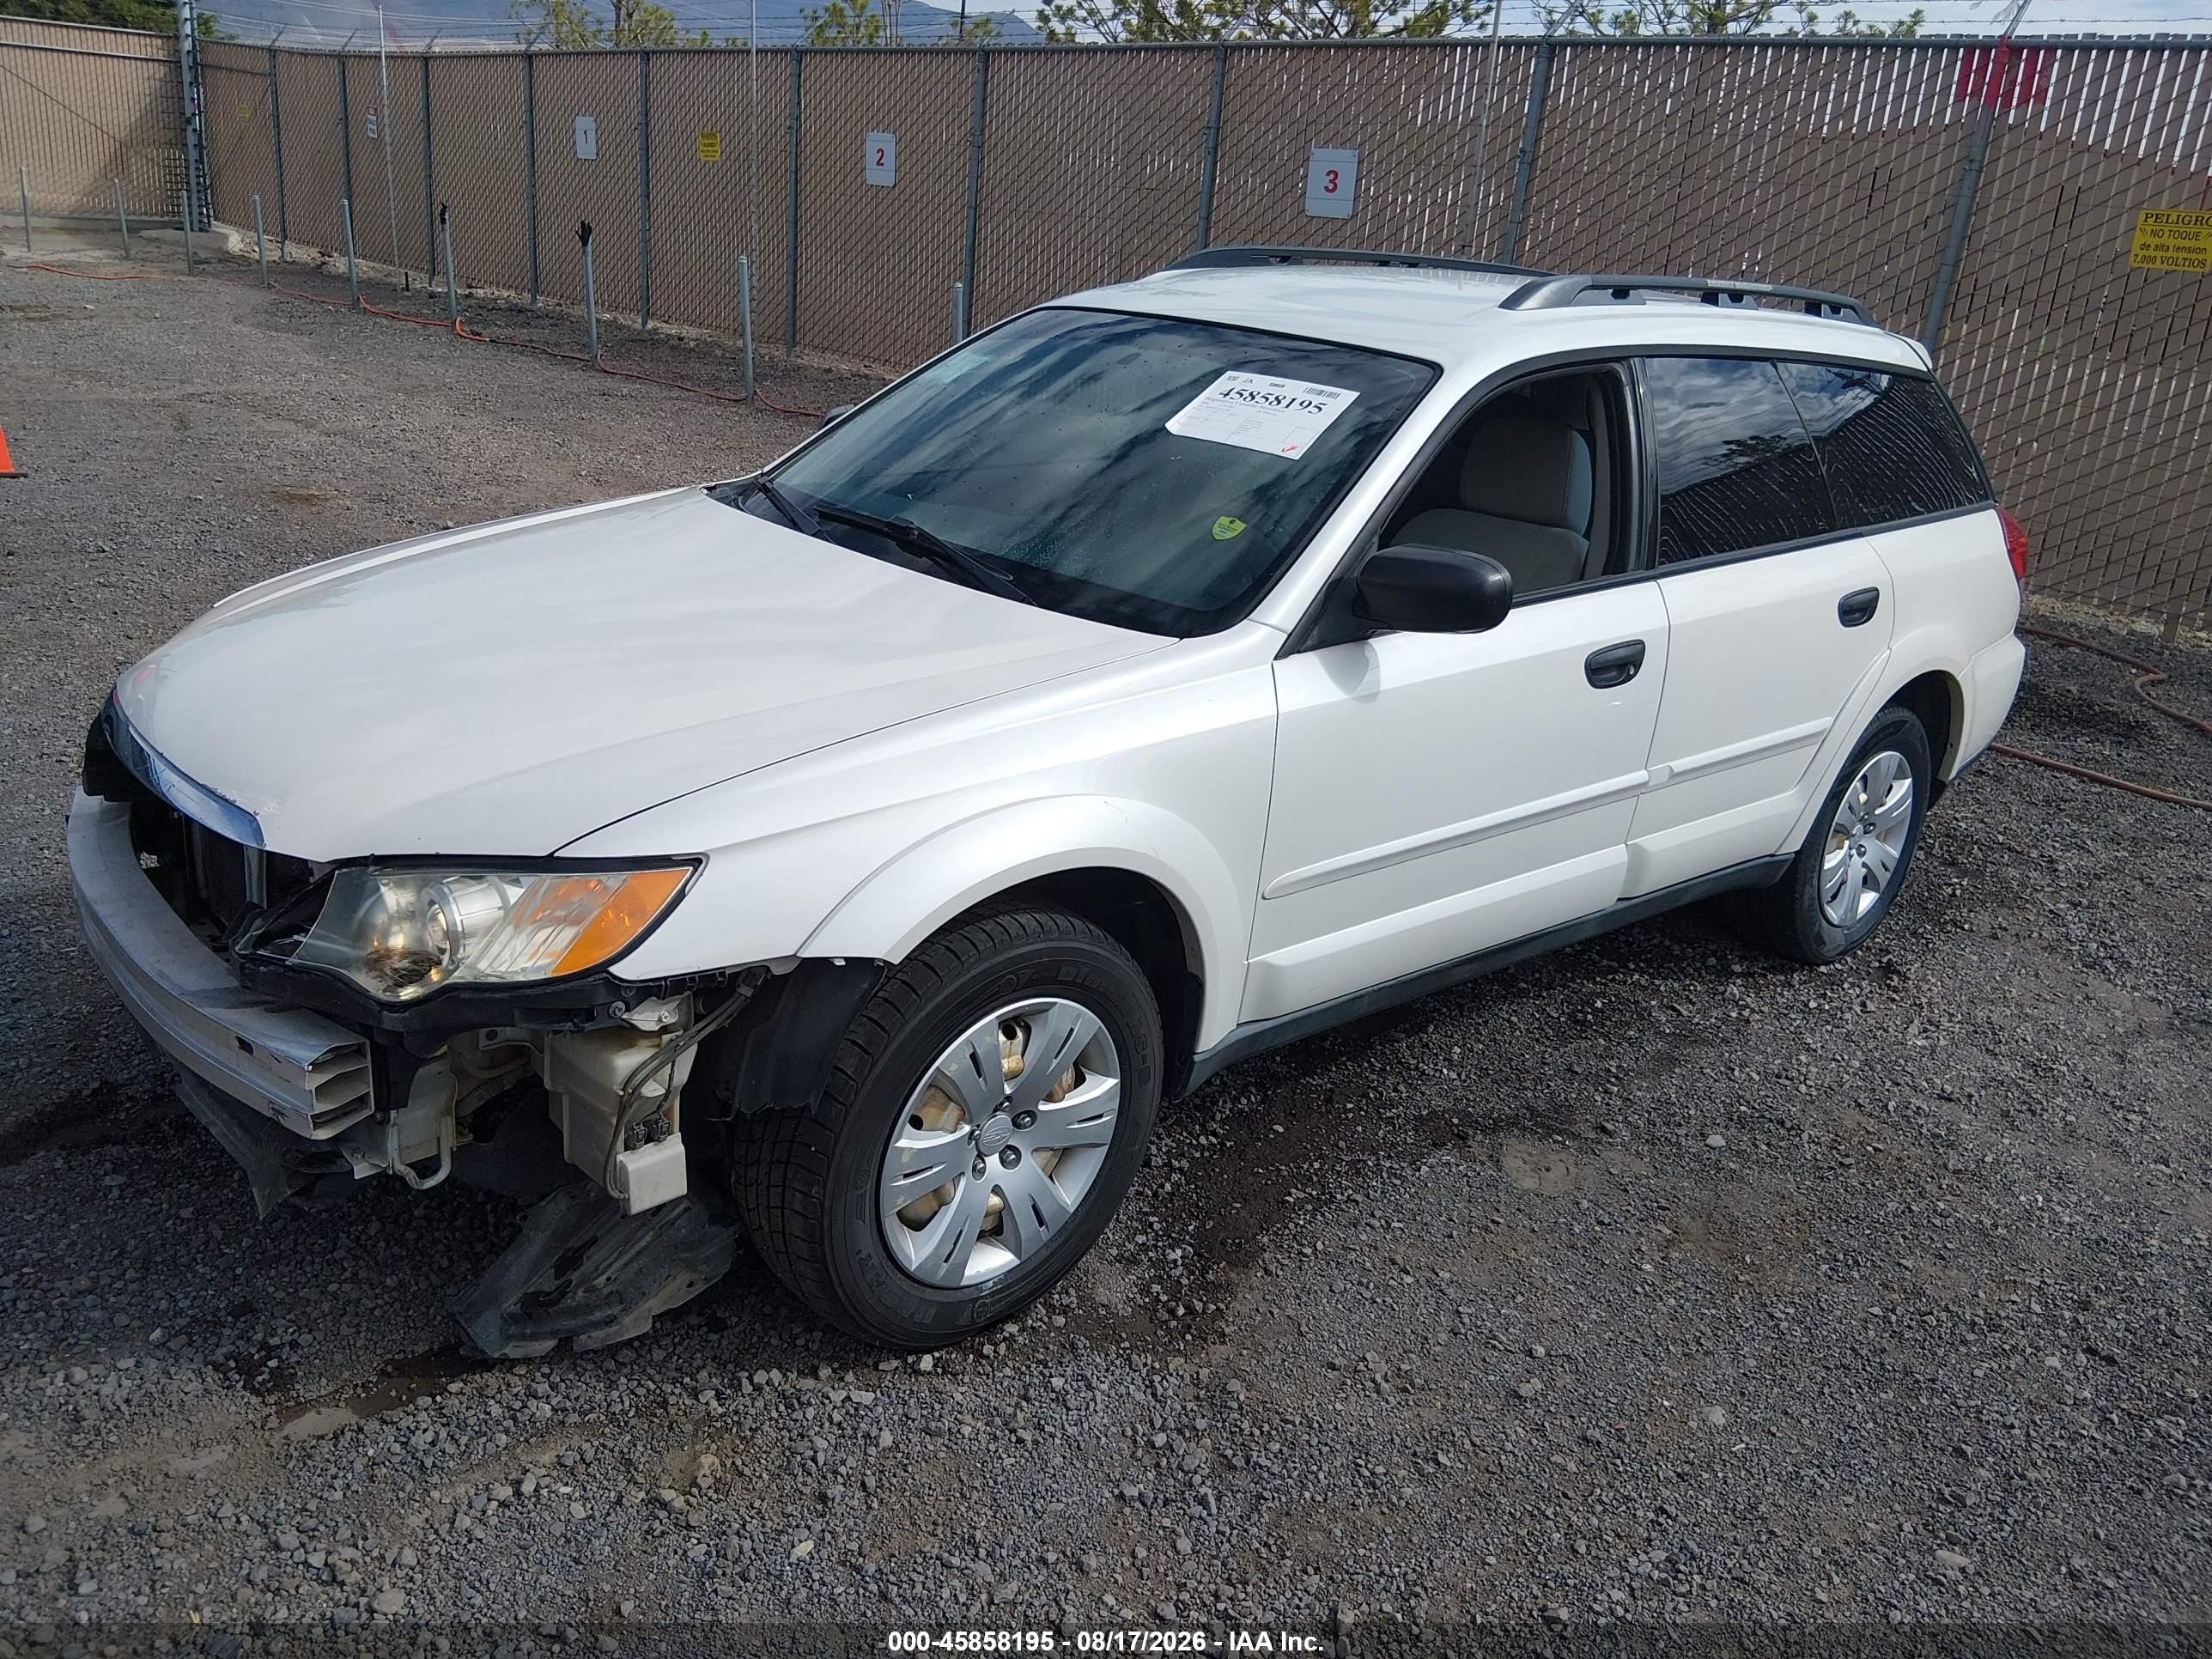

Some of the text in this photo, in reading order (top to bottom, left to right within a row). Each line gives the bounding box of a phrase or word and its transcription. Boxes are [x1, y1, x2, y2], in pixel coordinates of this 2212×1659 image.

[583, 130, 588, 144] 1
[876, 148, 884, 167] 2
[1323, 169, 1339, 193] 3
[2149, 228, 2203, 241] NO TOQUE
[2139, 241, 2208, 255] de alta tension
[2133, 254, 2208, 269] 7,000 VOLTIOS
[1218, 386, 1328, 416] 45858195
